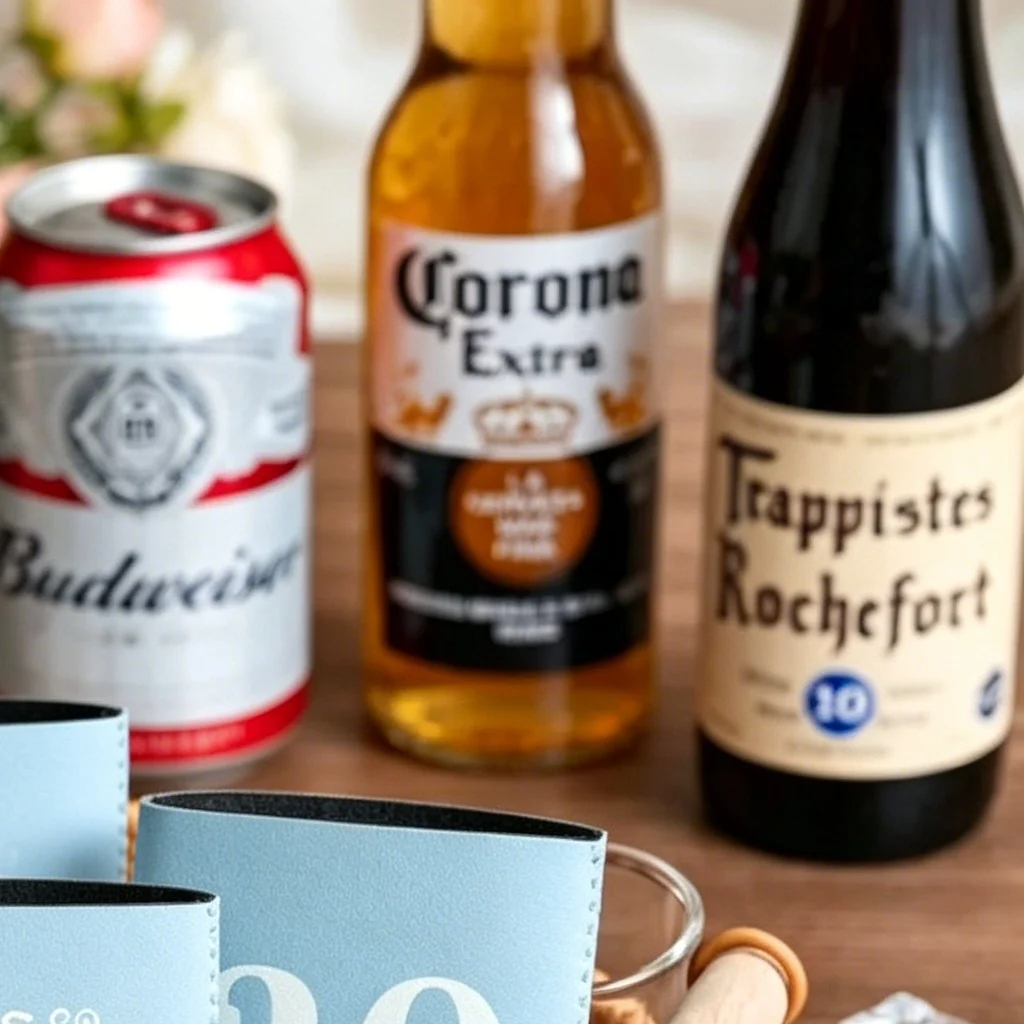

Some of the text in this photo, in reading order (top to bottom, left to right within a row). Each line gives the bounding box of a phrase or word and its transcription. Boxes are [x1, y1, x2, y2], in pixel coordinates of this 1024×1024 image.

[395, 248, 642, 339] Corona
[462, 330, 603, 377] Extra
[718, 434, 994, 554] Trappistes
[716, 534, 990, 653] Rochefort
[810, 681, 868, 725] 10
